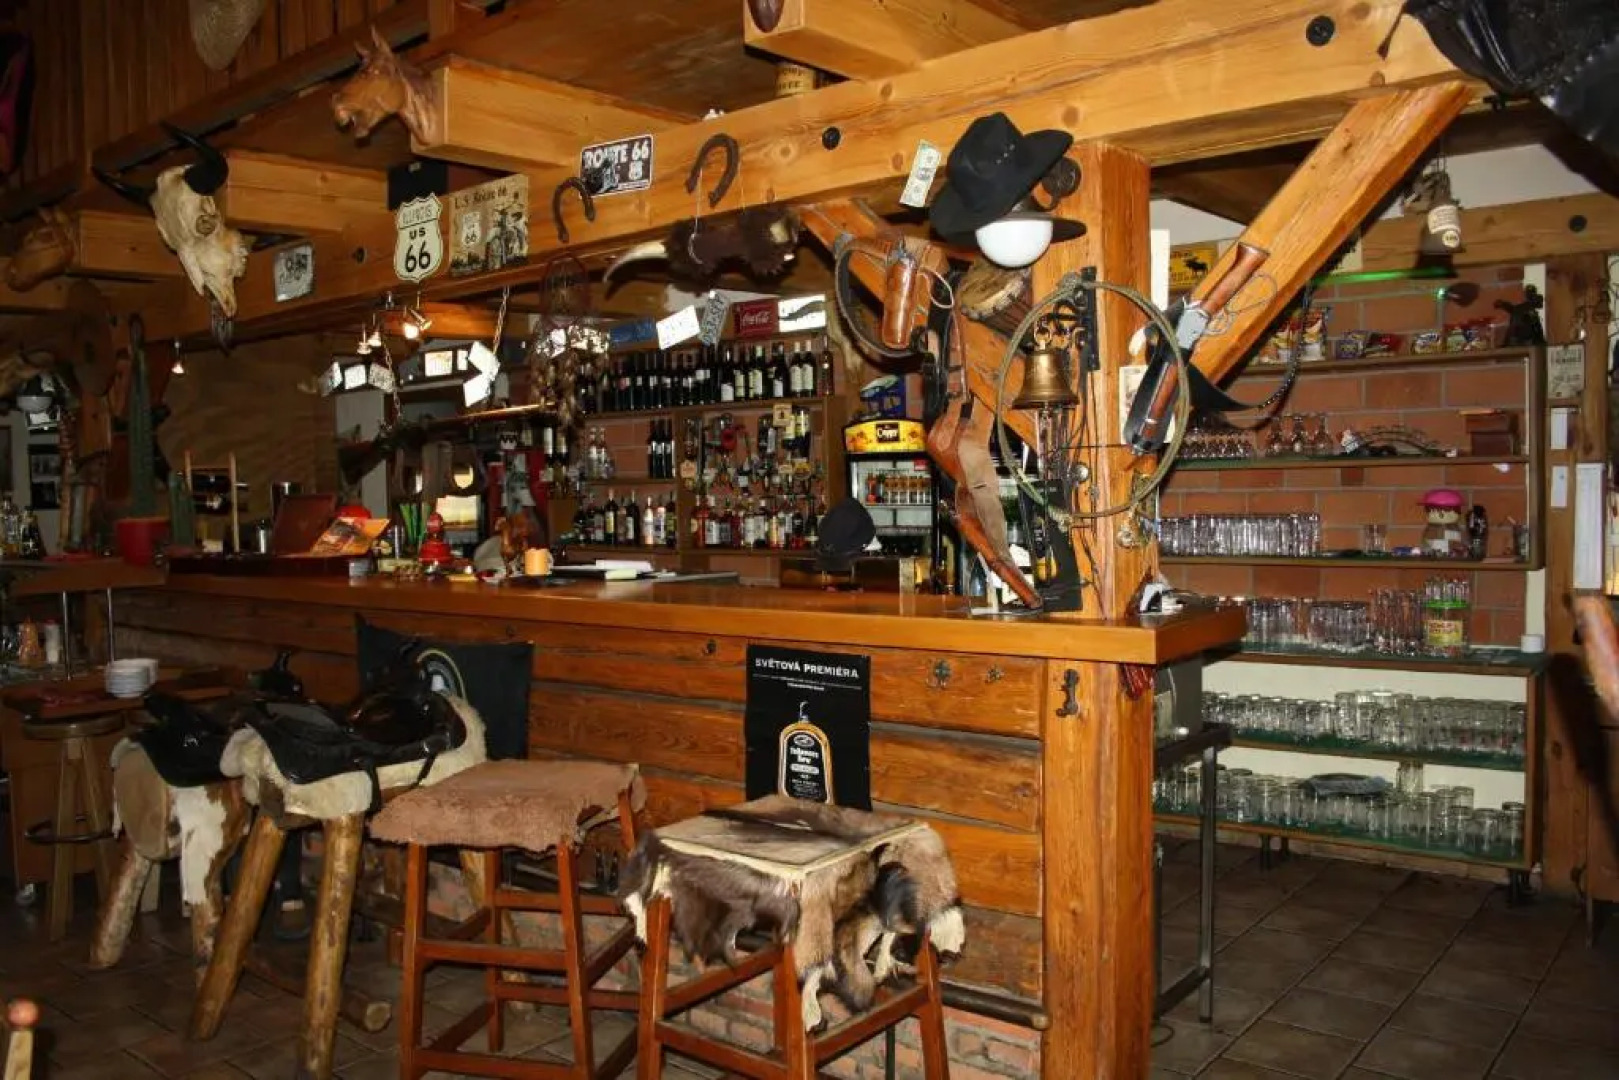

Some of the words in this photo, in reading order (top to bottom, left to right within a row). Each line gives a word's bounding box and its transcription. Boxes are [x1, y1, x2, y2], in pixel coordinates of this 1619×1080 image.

[631, 139, 650, 161] 66
[409, 227, 426, 240] US
[405, 240, 431, 272] 66
[755, 657, 801, 672] SVĚTOVÁ
[803, 664, 859, 678] PREMIÉRA
